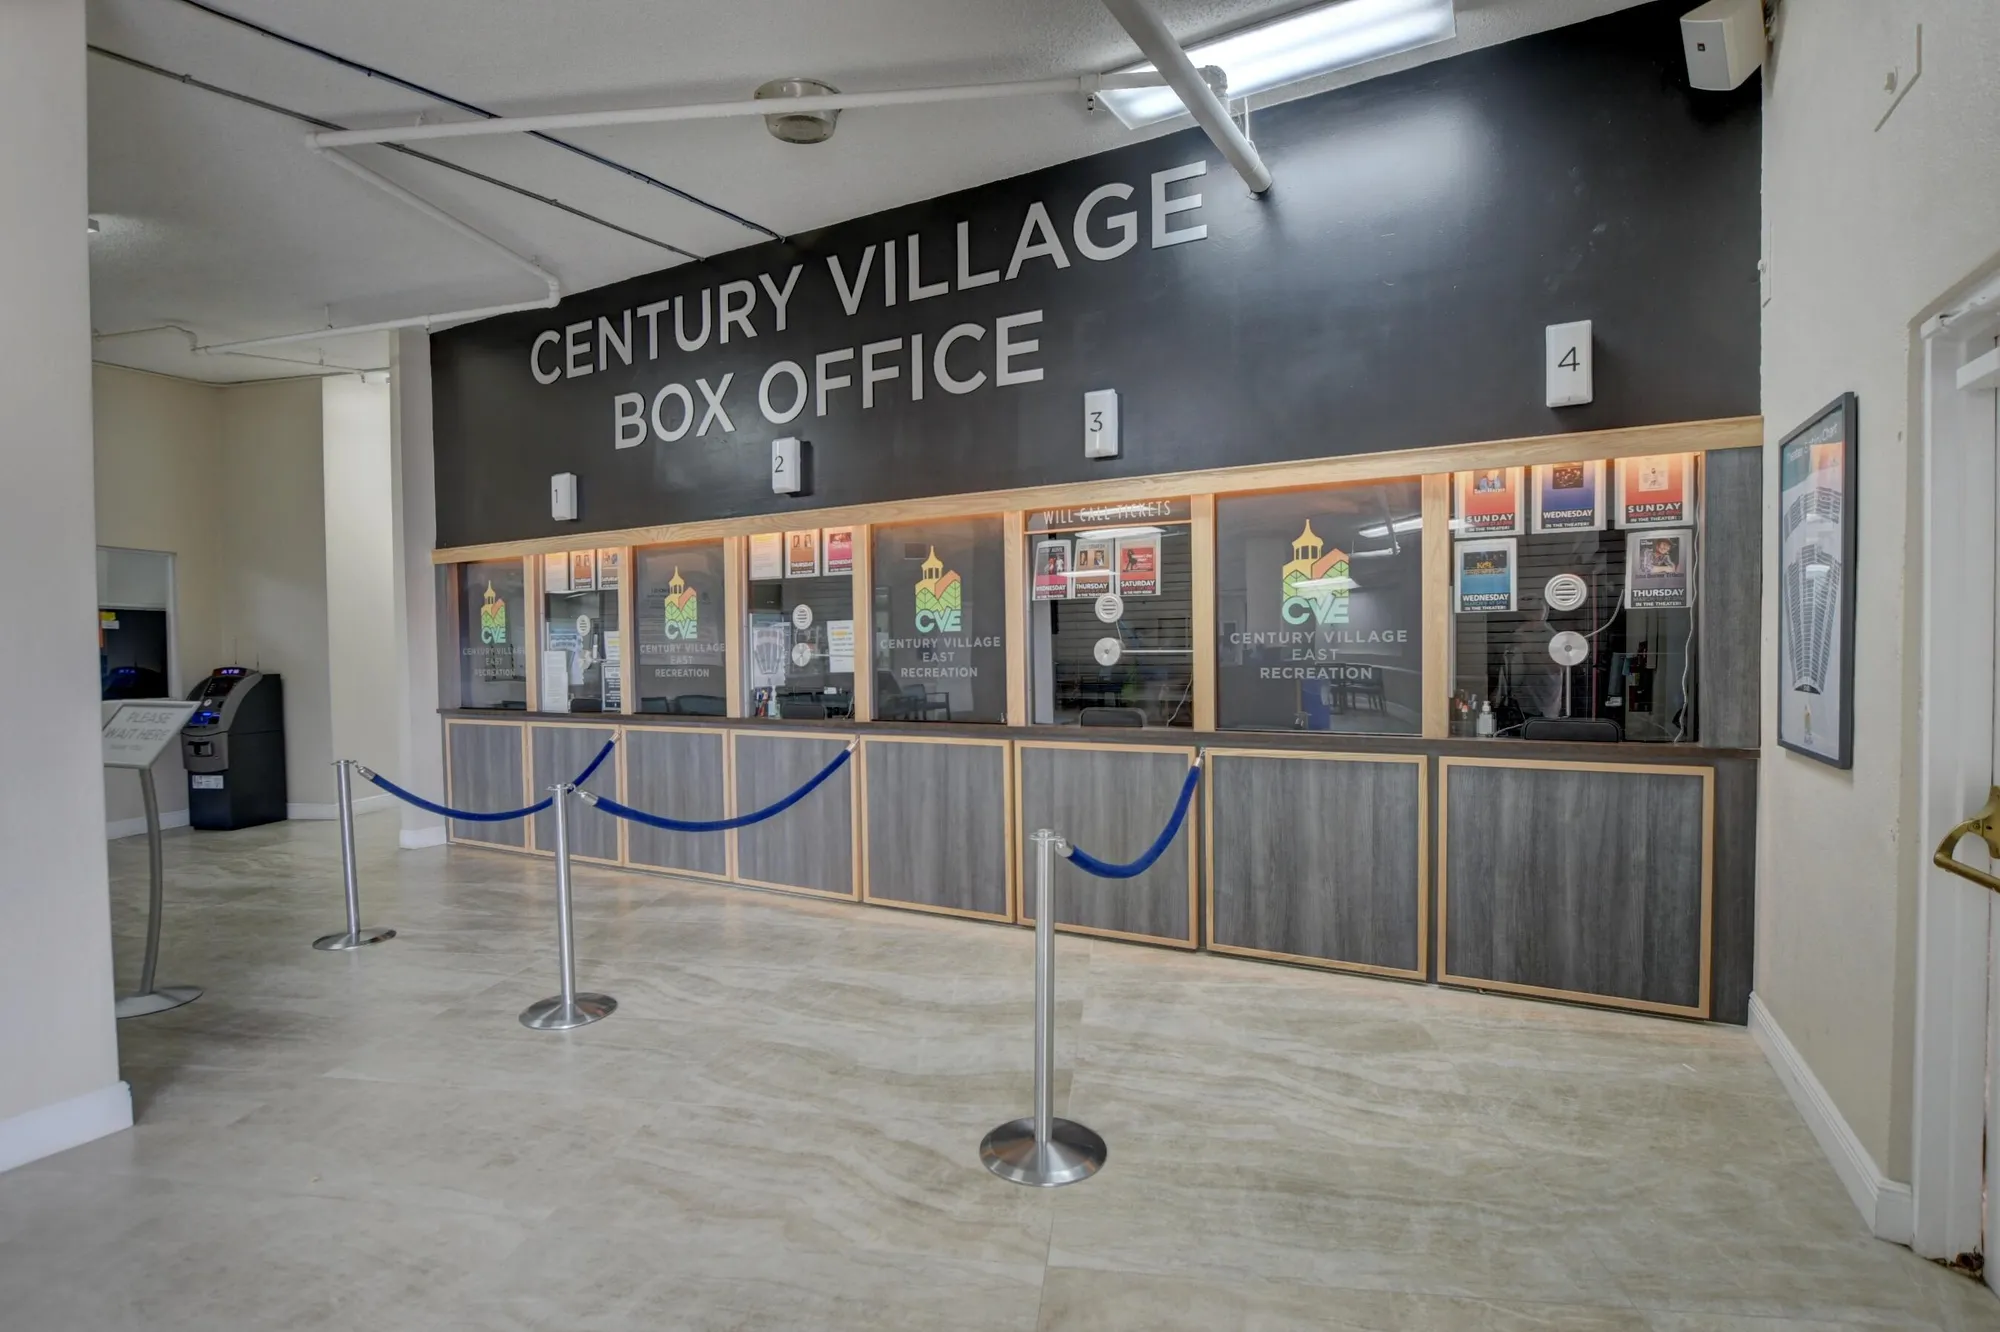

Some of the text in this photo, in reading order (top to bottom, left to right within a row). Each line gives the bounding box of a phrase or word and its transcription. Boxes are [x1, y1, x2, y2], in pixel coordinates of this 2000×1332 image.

[530, 160, 1208, 385] CENTURY VILLAGE
[1558, 346, 1581, 372] 4
[614, 309, 1045, 450] BOX OFFICE
[1089, 411, 1103, 433] 3
[774, 455, 785, 473] 2
[554, 488, 559, 504] 1
[1043, 500, 1171, 525] WILL CALL TICKETS
[1543, 509, 1593, 519] WEDNESDAY
[1627, 502, 1681, 513] SUNDAY
[1466, 513, 1514, 523] SUNDAY
[1120, 579, 1156, 587] SATURDAY
[1463, 593, 1509, 602] WEDNESDAY
[1632, 588, 1685, 598] THURSDAY
[1281, 592, 1350, 626] CVE
[915, 606, 962, 634] CVE
[481, 626, 507, 644] CVE
[664, 619, 698, 641] CVE
[880, 636, 1001, 650] CENTURY VILLAGE
[1229, 629, 1408, 645] CENTURY VILLAGE
[639, 642, 726, 654] CENTURY VILLAGE
[1292, 648, 1340, 661] EAST
[669, 655, 694, 665] EAST
[922, 651, 956, 663] EAST
[655, 668, 710, 678] RECREATION
[901, 667, 978, 678] RECREATION
[1260, 667, 1373, 680] RECREATION
